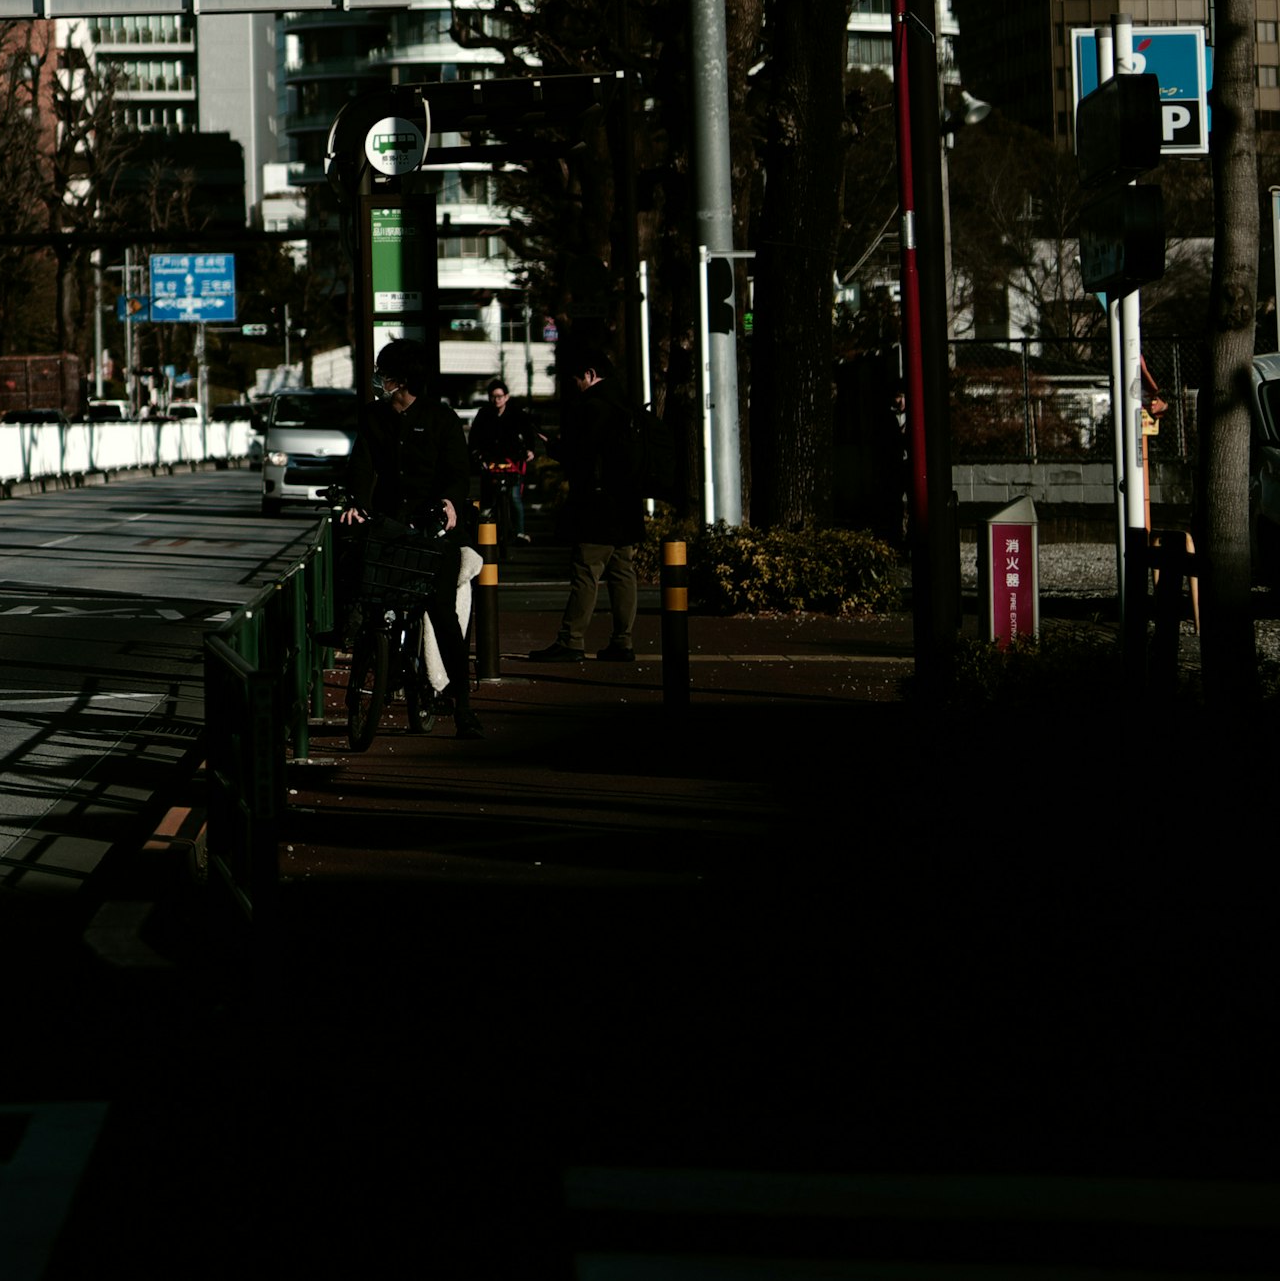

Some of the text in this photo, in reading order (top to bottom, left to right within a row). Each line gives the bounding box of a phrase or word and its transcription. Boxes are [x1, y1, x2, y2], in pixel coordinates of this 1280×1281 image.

[1162, 105, 1191, 141] P
[1005, 538, 1020, 588] 消火器
[1009, 592, 1017, 612] FIRE
